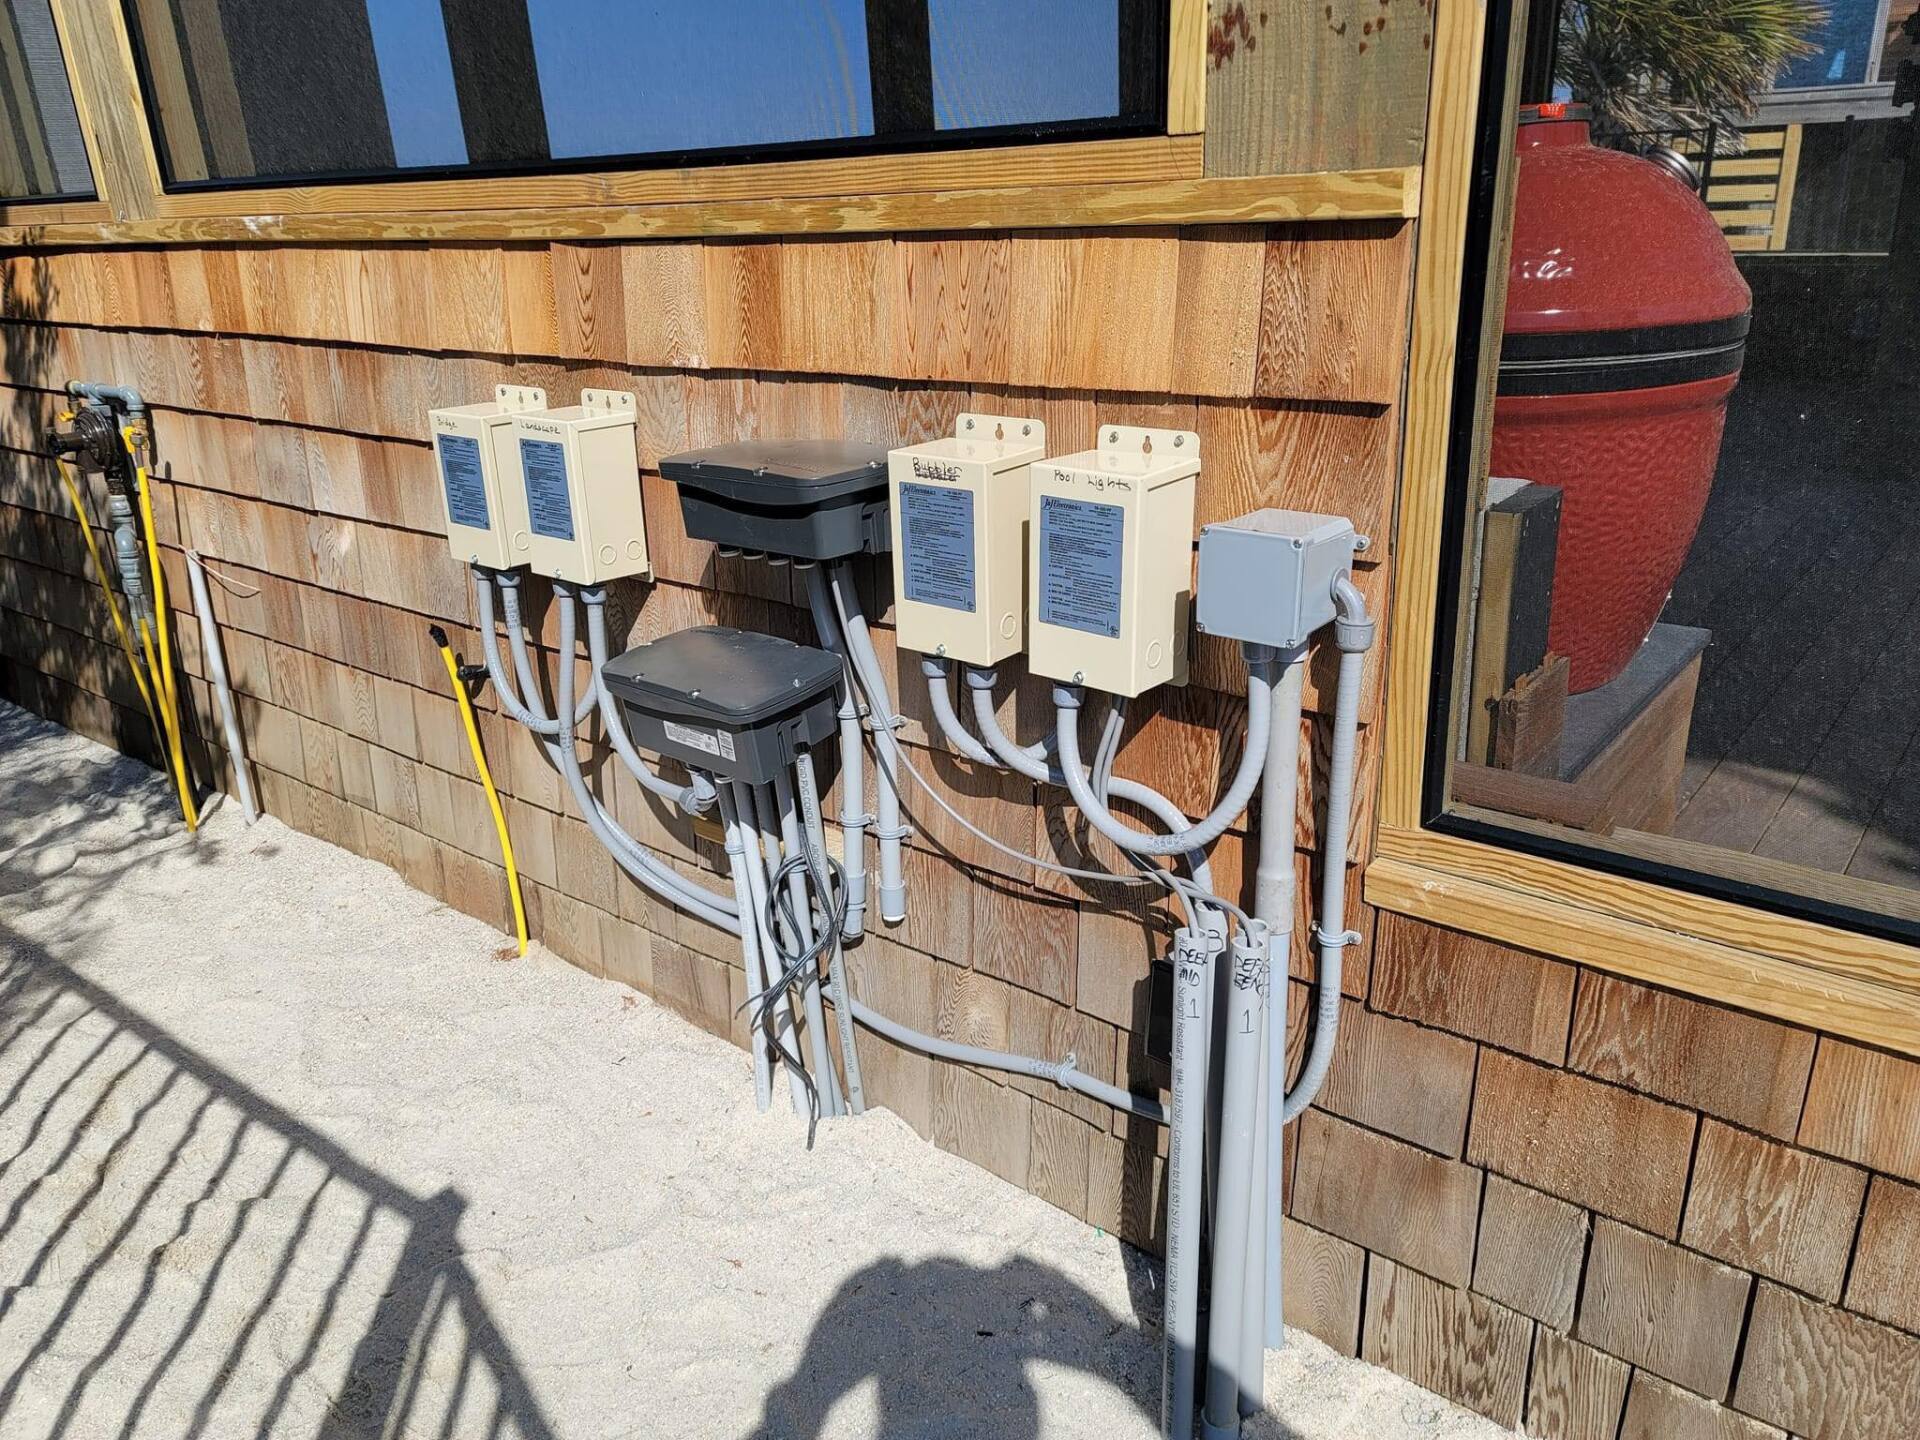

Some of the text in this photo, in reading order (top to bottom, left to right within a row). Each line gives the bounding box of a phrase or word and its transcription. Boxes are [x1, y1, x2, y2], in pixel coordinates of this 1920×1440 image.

[913, 457, 962, 476] Bubbler
[1054, 469, 1132, 491] Pool Lights
[1175, 986, 1187, 1020] Sunlight
[1186, 998, 1201, 1019] 1
[1239, 1009, 1255, 1034] 1
[1174, 1022, 1186, 1060] Resistant
